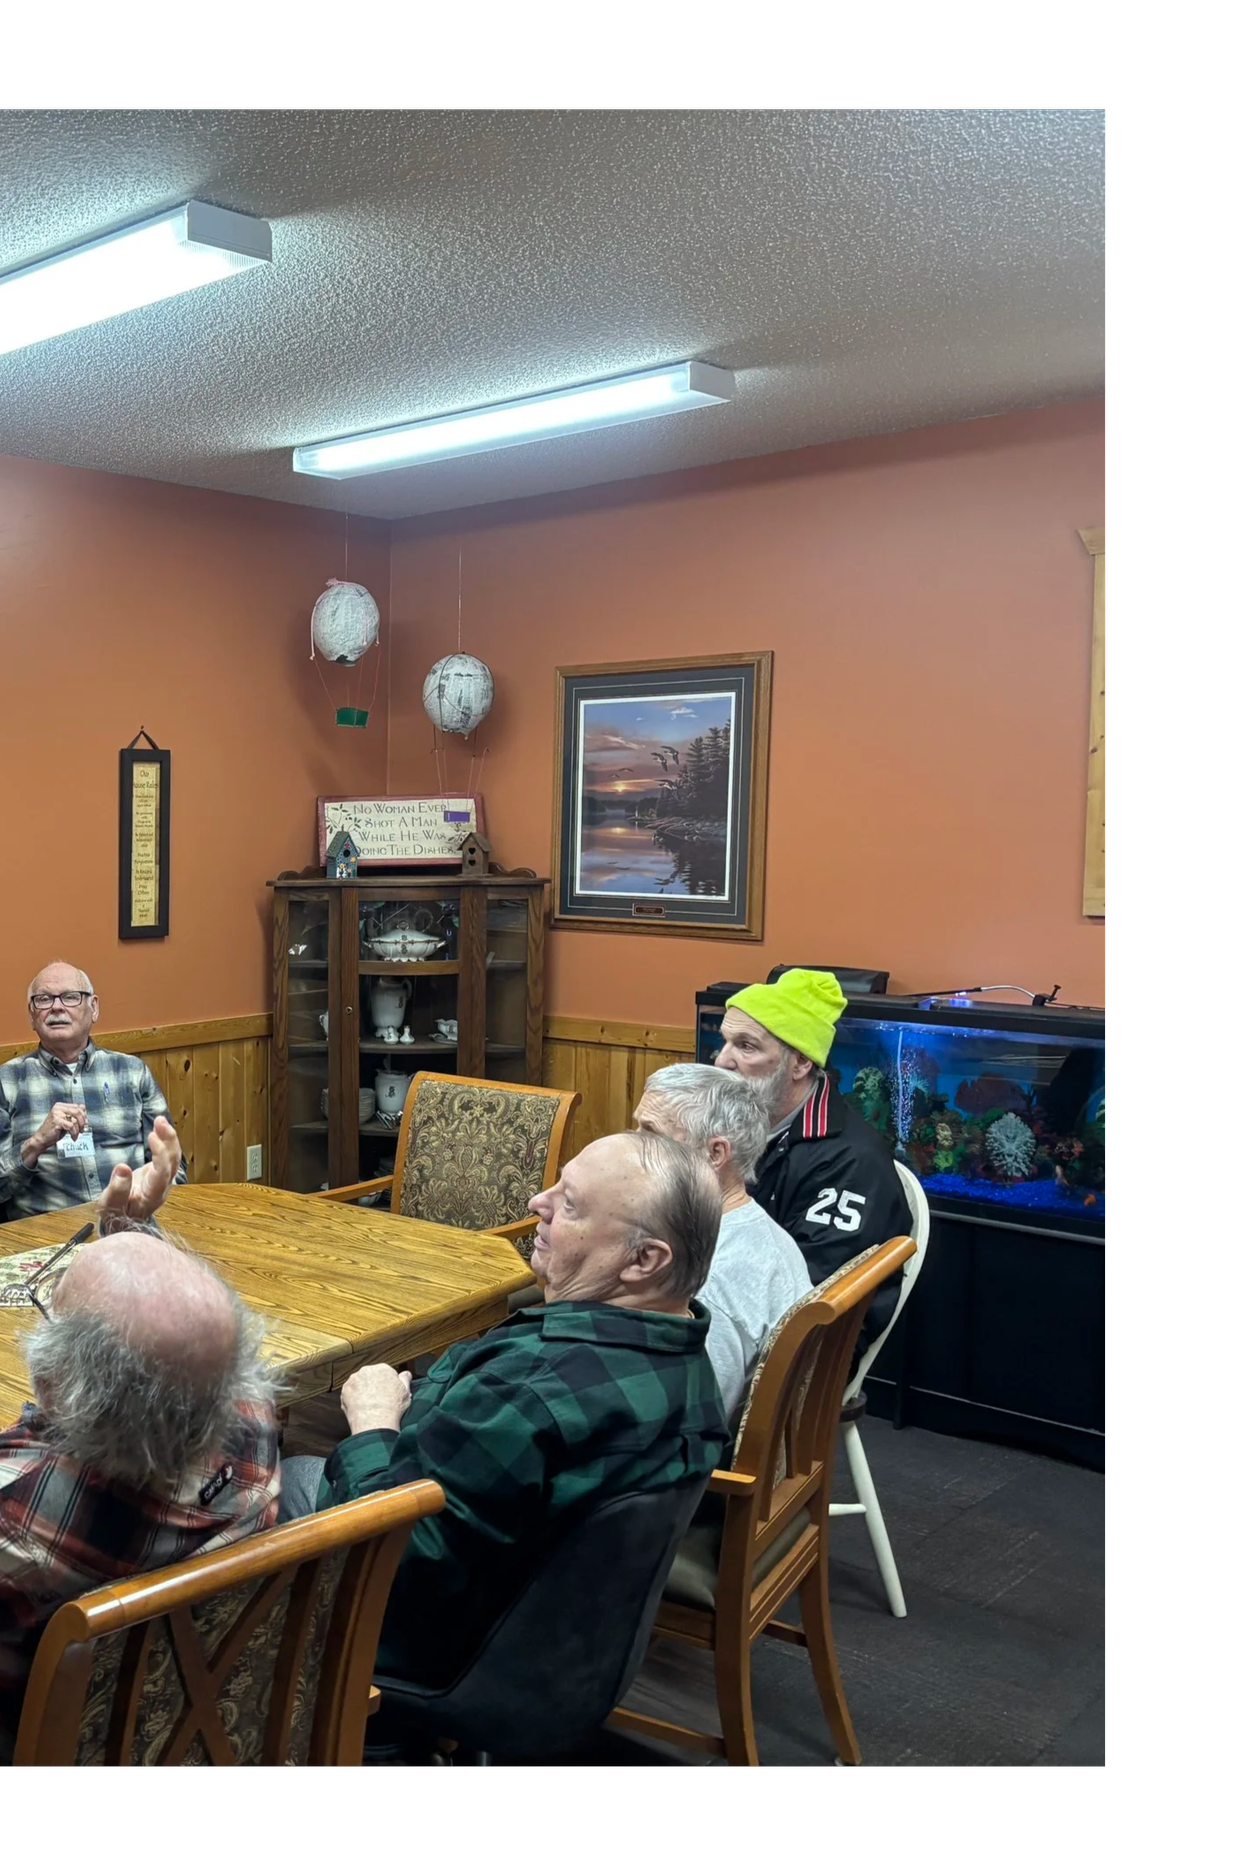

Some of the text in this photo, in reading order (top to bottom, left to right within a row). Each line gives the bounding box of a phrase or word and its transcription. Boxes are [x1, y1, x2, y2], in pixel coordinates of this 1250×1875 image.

[353, 804, 372, 815] NO
[373, 803, 415, 814] WOMAN
[364, 816, 438, 828] SHOT A MAN
[358, 829, 447, 842] WHILE HE WAS
[386, 844, 411, 855] THE
[805, 1187, 867, 1232] 25
